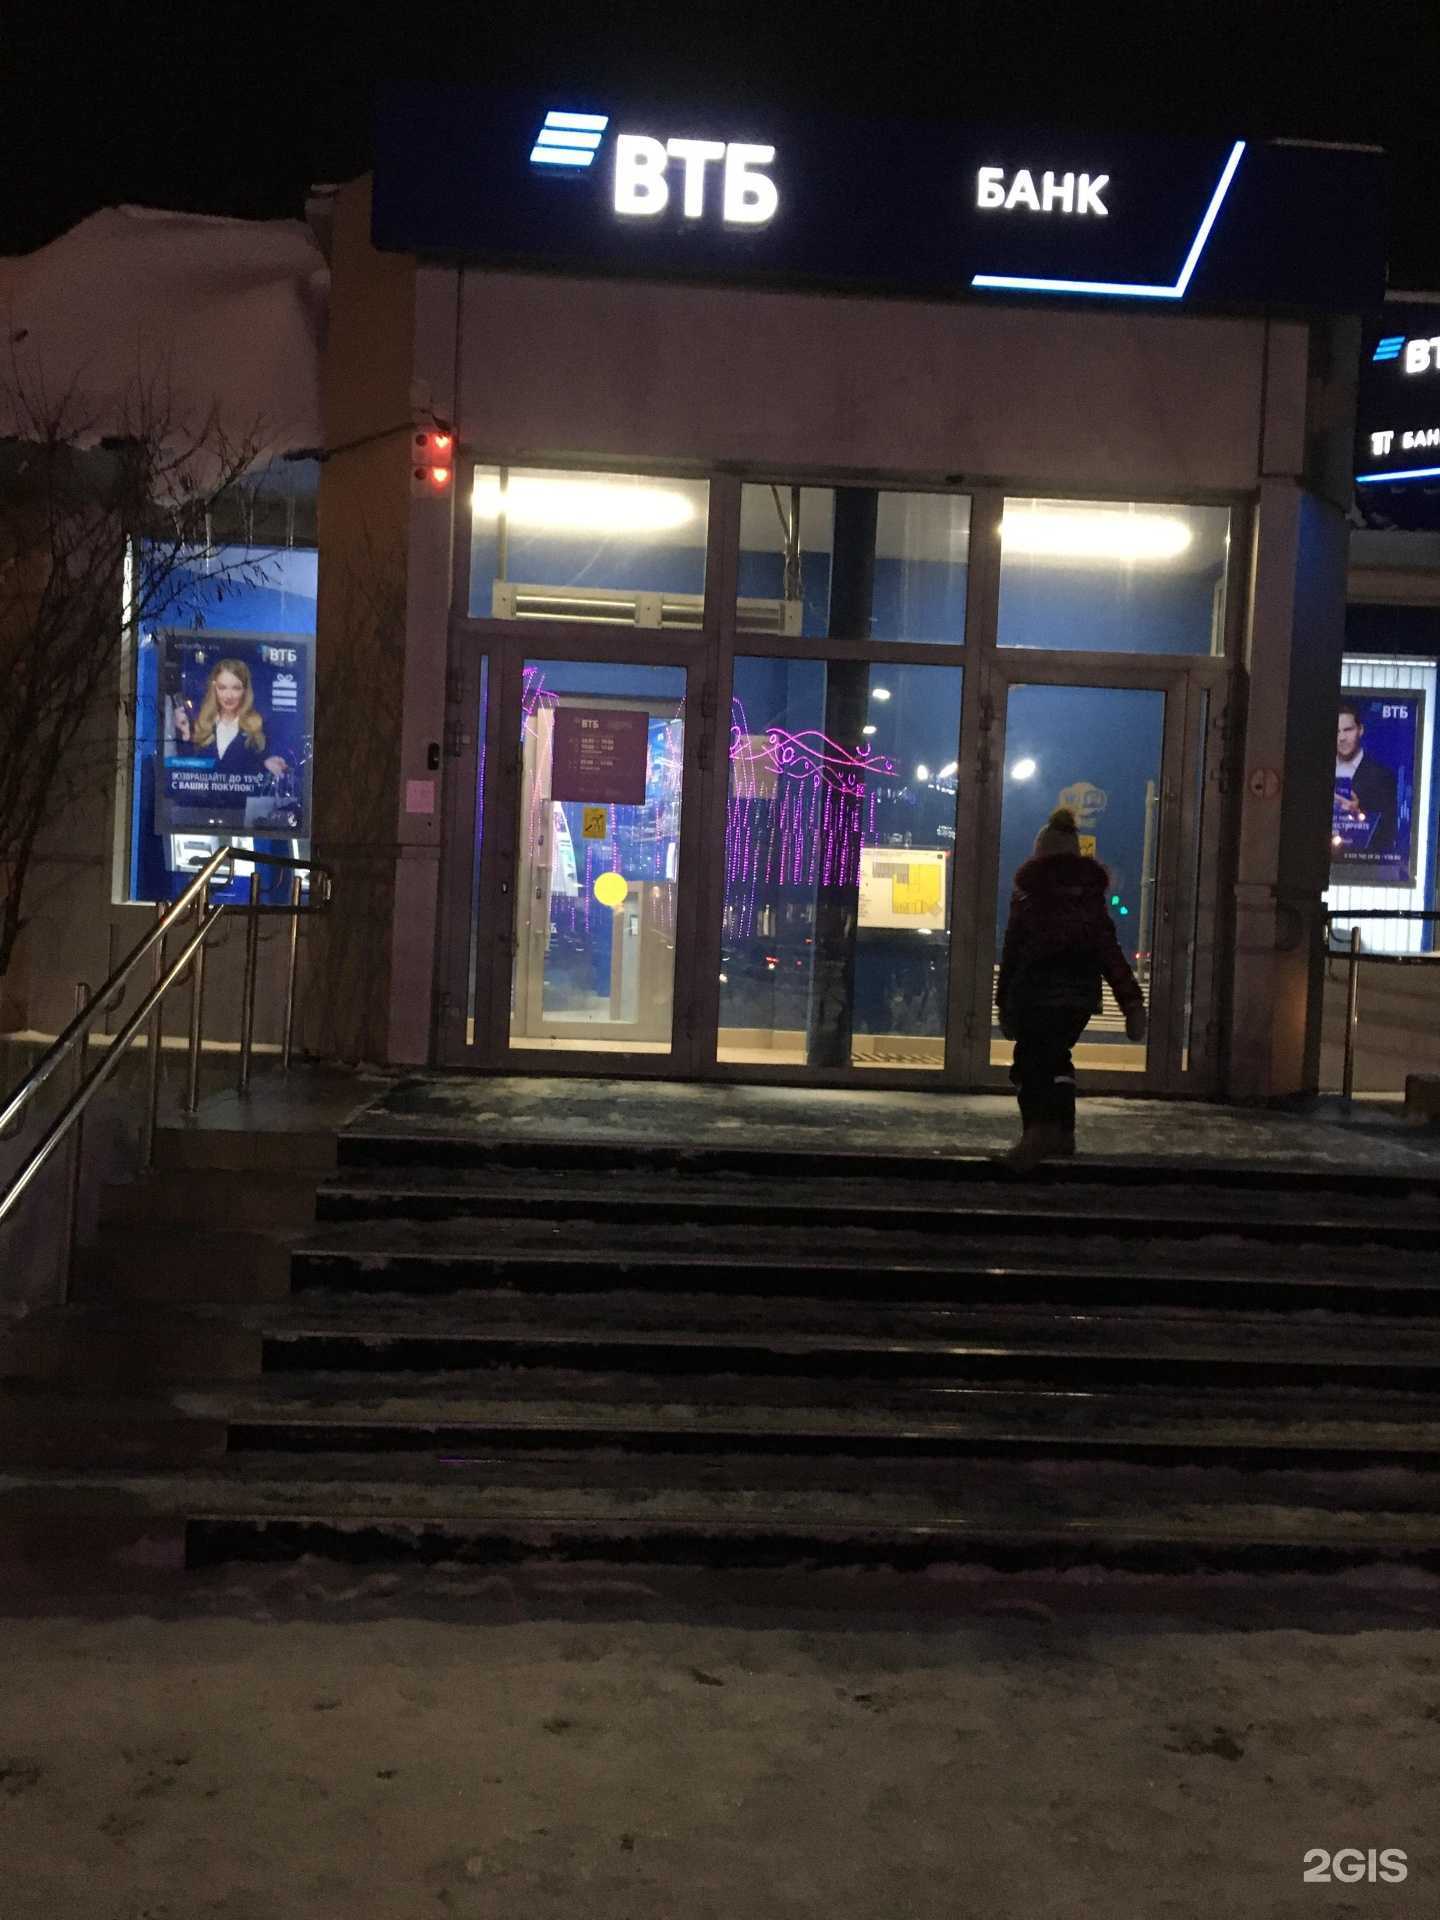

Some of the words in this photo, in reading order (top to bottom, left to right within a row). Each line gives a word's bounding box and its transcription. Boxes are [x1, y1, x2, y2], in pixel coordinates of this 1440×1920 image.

[613, 134, 778, 225] ВТБ
[976, 166, 1110, 217] БАНК
[1402, 428, 1440, 449] БАН
[269, 647, 297, 662] ВТБ
[1382, 705, 1409, 719] ВТБ
[171, 781, 178, 790] С
[178, 782, 210, 791] ВАШИХ
[229, 774, 242, 783] ДО
